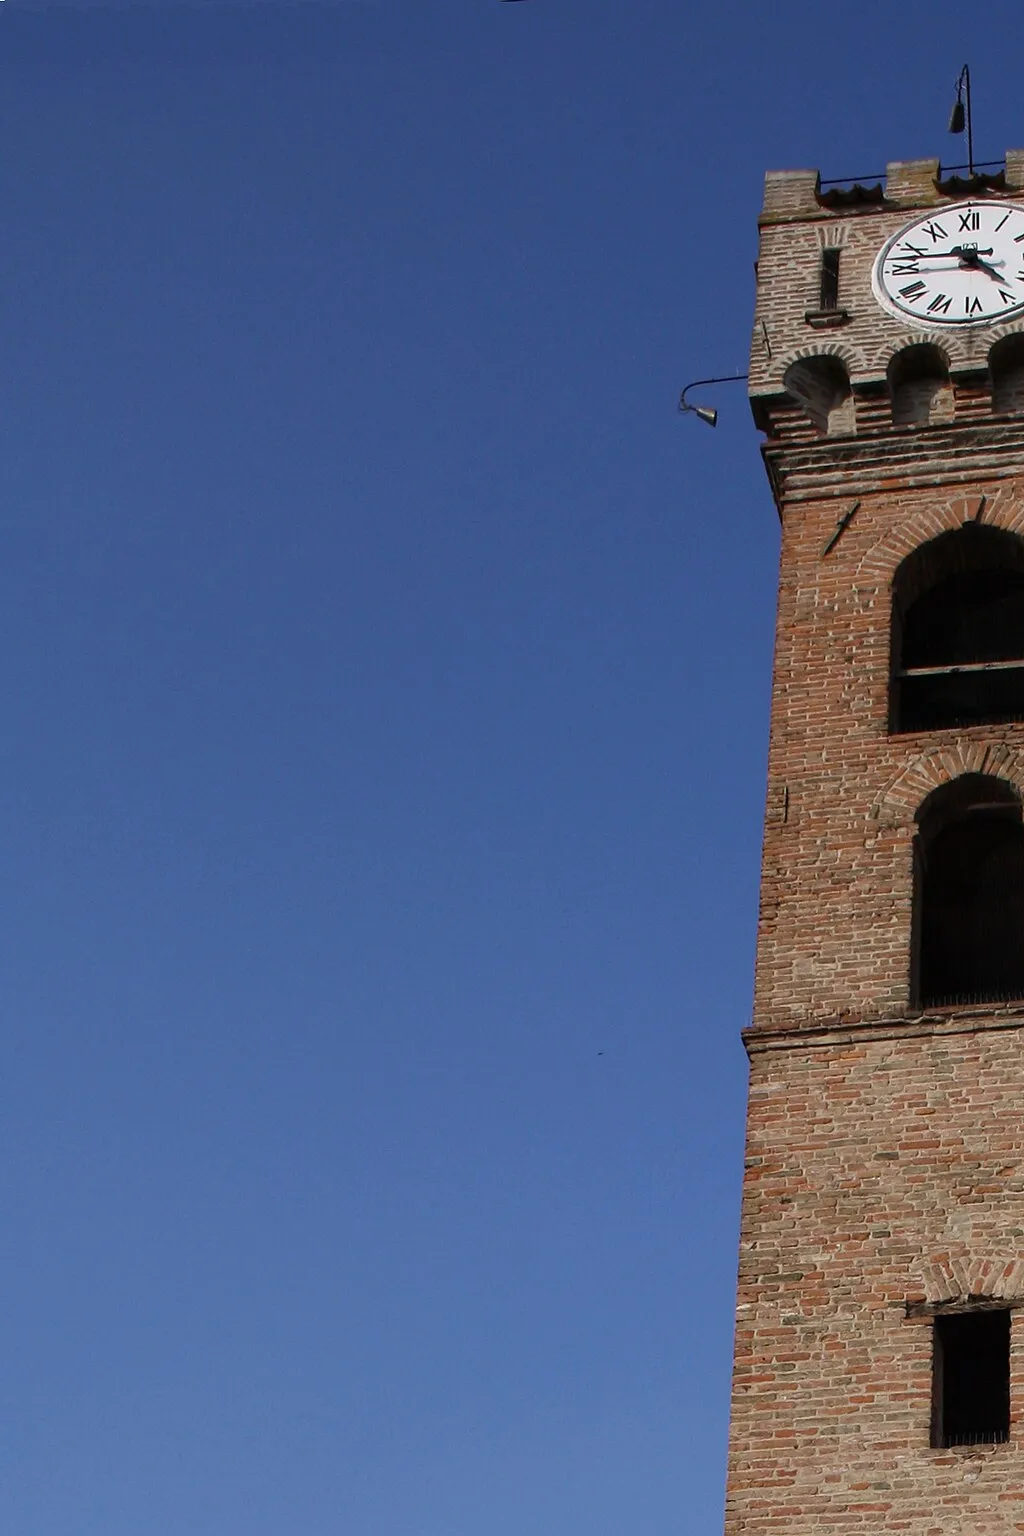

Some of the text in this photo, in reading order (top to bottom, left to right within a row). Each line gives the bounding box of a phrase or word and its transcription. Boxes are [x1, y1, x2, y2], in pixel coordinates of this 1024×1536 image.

[958, 211, 980, 232] XII
[922, 222, 948, 243] XI
[900, 242, 928, 258] X
[892, 262, 919, 276] IX
[898, 280, 929, 304] VIII
[998, 289, 1016, 304] V
[927, 294, 953, 314] VII
[965, 296, 983, 313] VI
